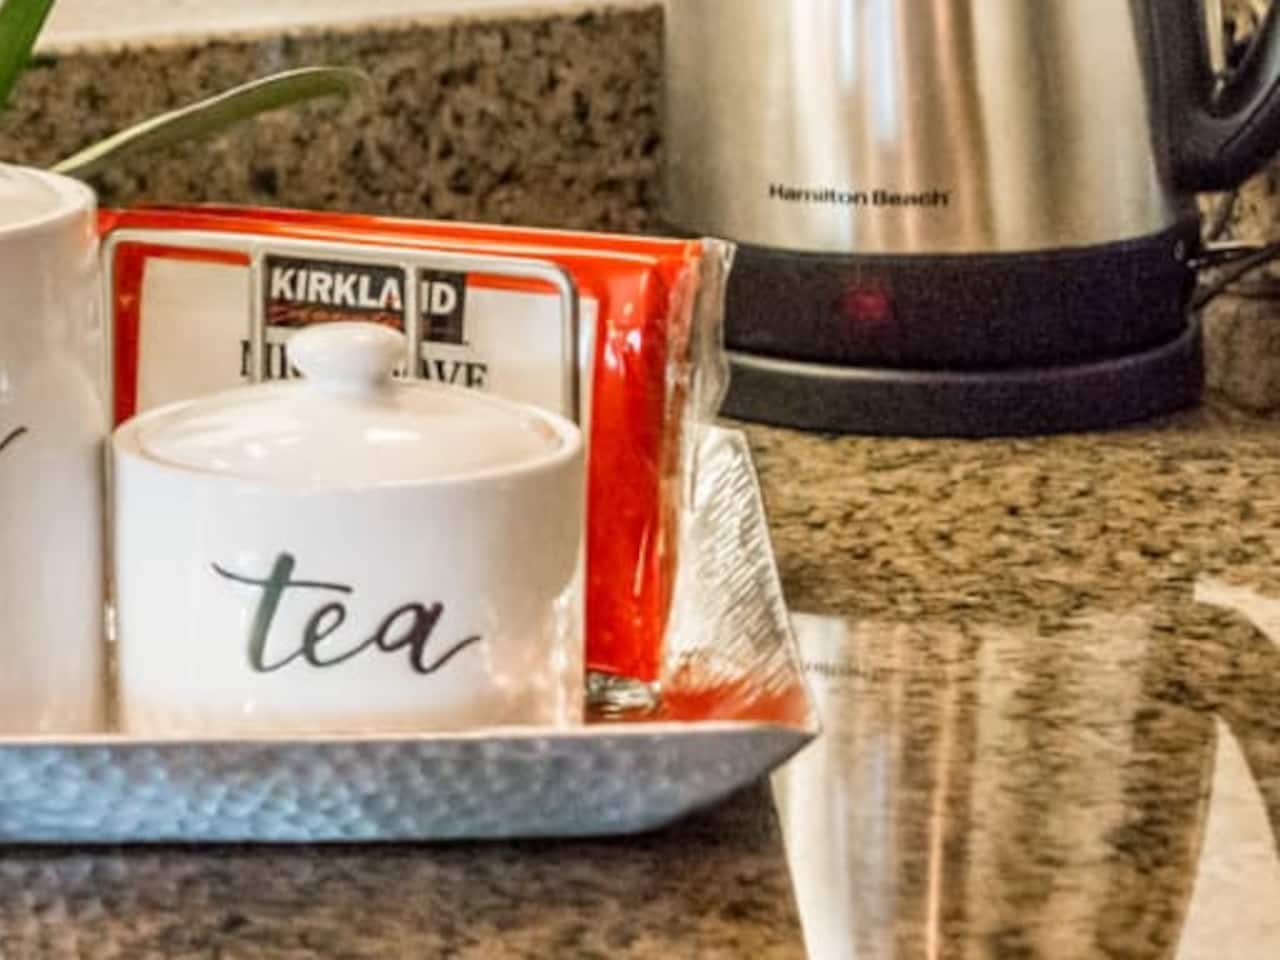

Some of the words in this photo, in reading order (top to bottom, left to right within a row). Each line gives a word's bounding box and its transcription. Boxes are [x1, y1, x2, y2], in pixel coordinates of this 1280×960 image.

[769, 184, 868, 206] Hamilton
[872, 188, 949, 207] Beach
[211, 551, 481, 675] tea
